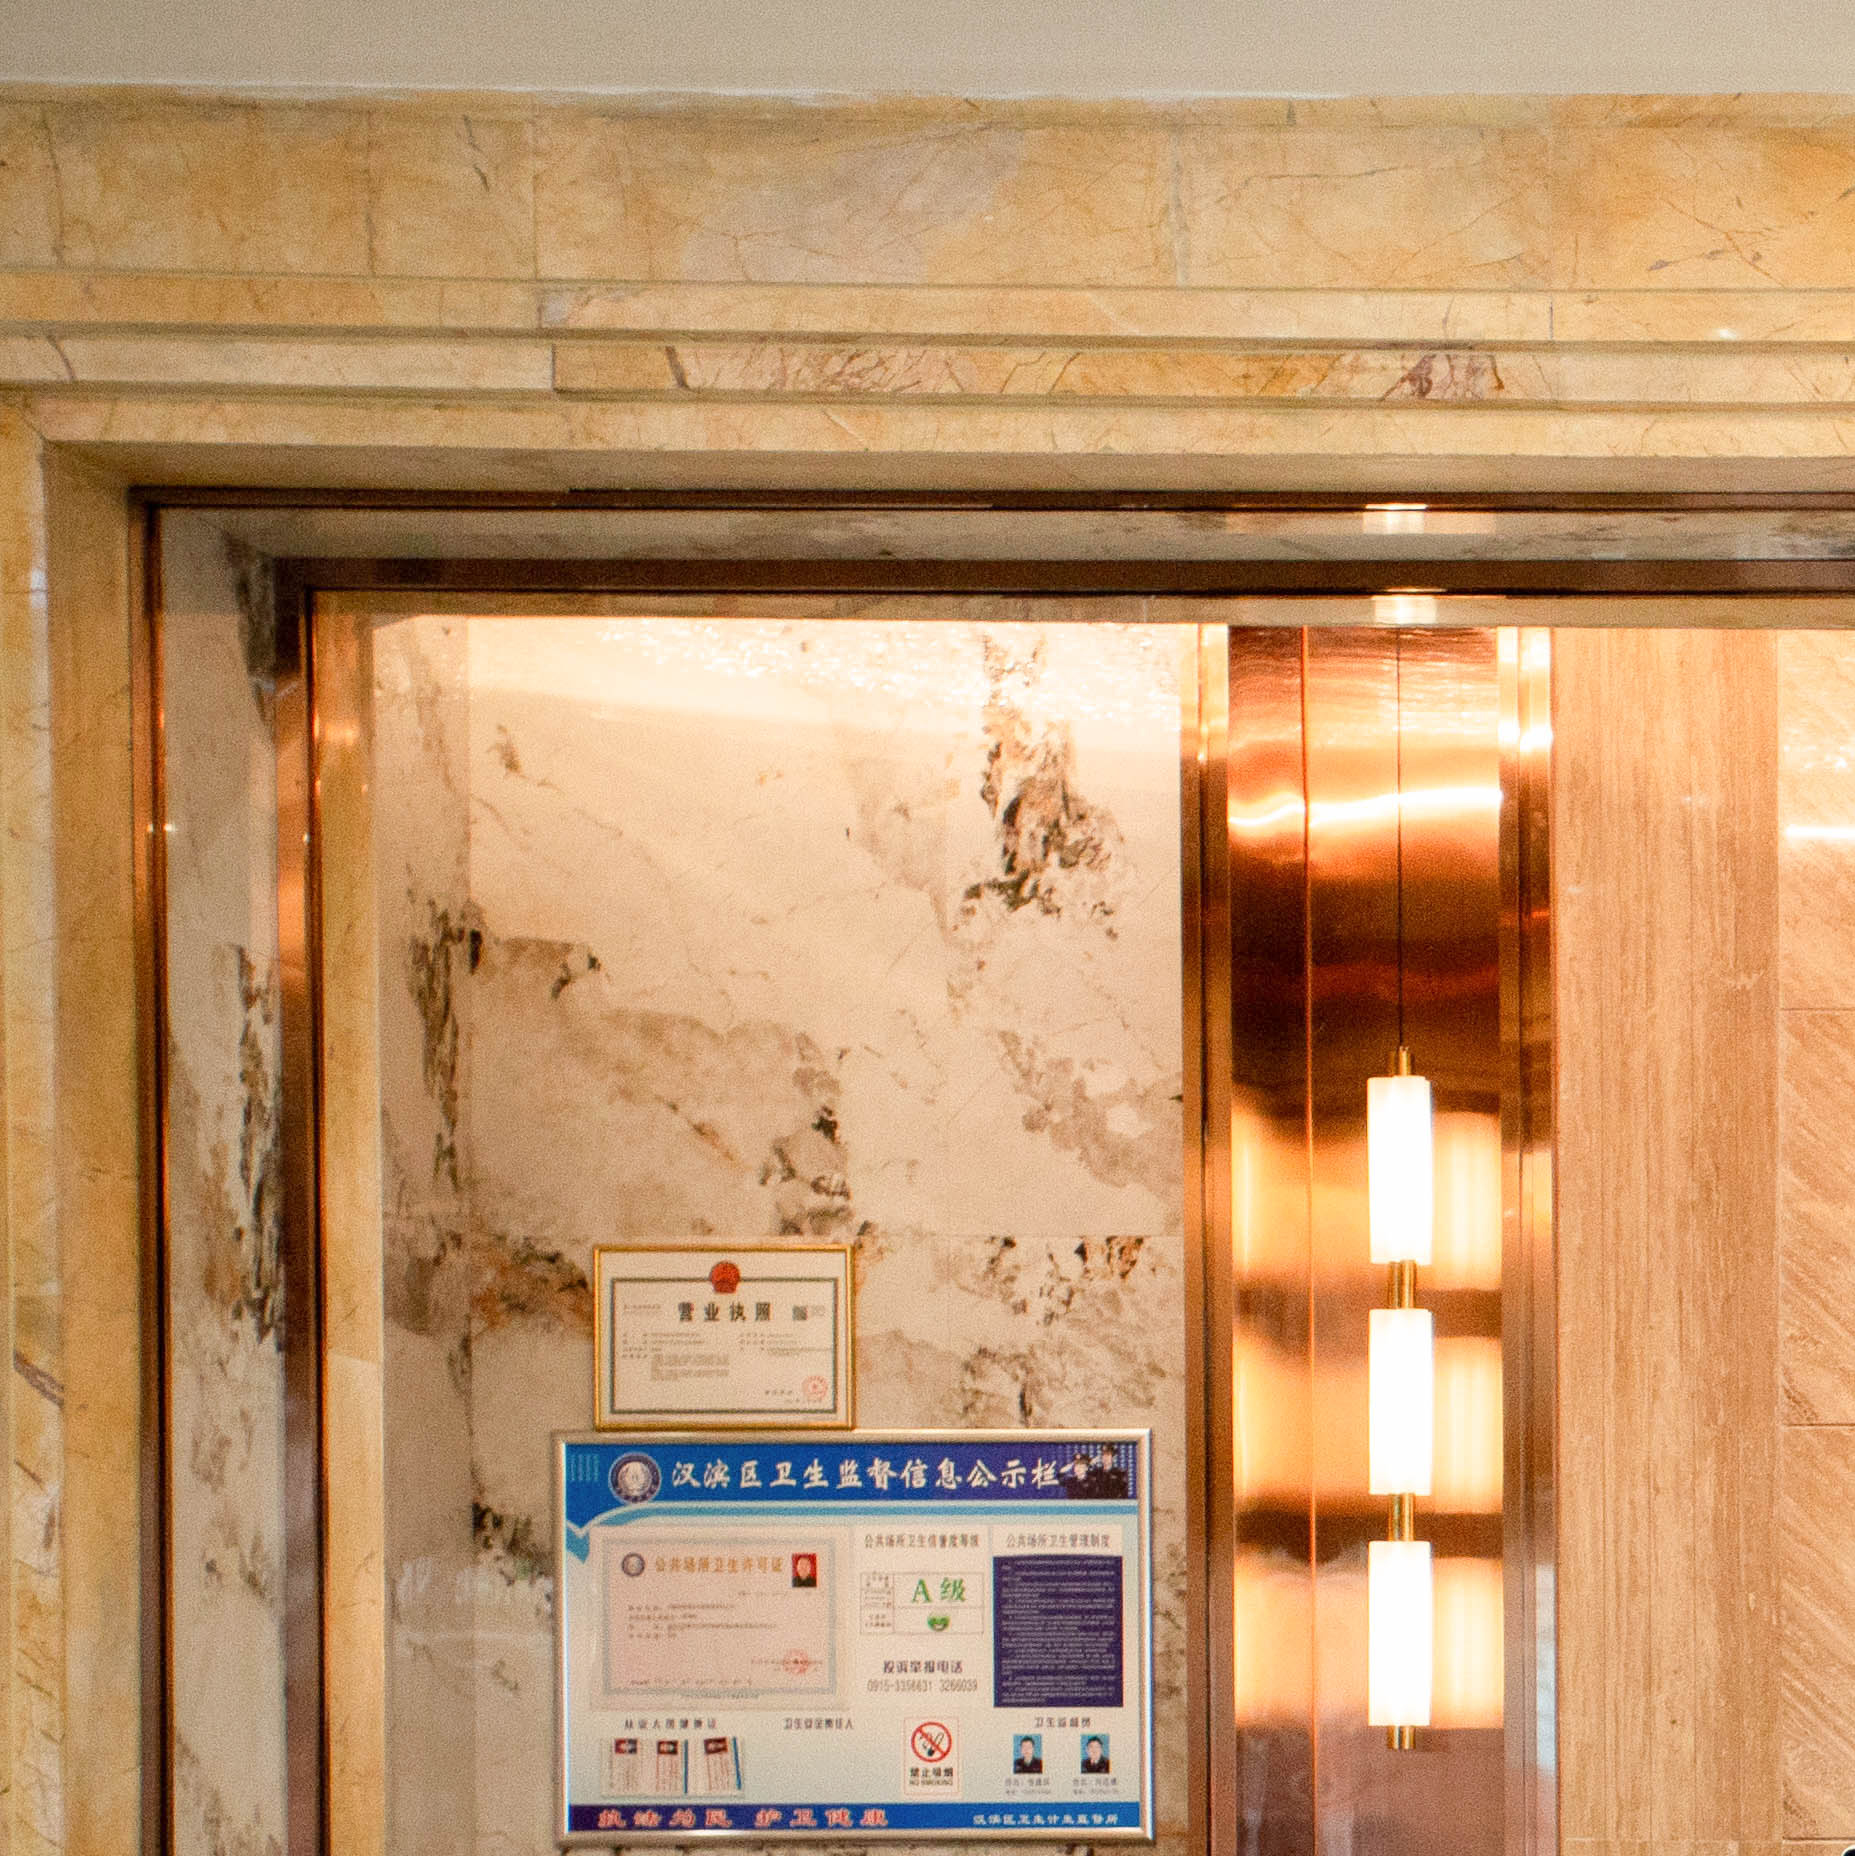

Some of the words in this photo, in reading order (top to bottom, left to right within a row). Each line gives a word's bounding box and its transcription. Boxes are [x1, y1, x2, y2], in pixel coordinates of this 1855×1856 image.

[678, 1302, 771, 1322] 营业执照
[672, 1458, 1060, 1490] 汉滨区卫生监督信息公示栏
[1006, 1533, 1111, 1549] 公共场所卫生管理制度
[655, 1556, 784, 1573] 公共场所卫生许可证
[883, 1659, 963, 1674] 投诉举报电话
